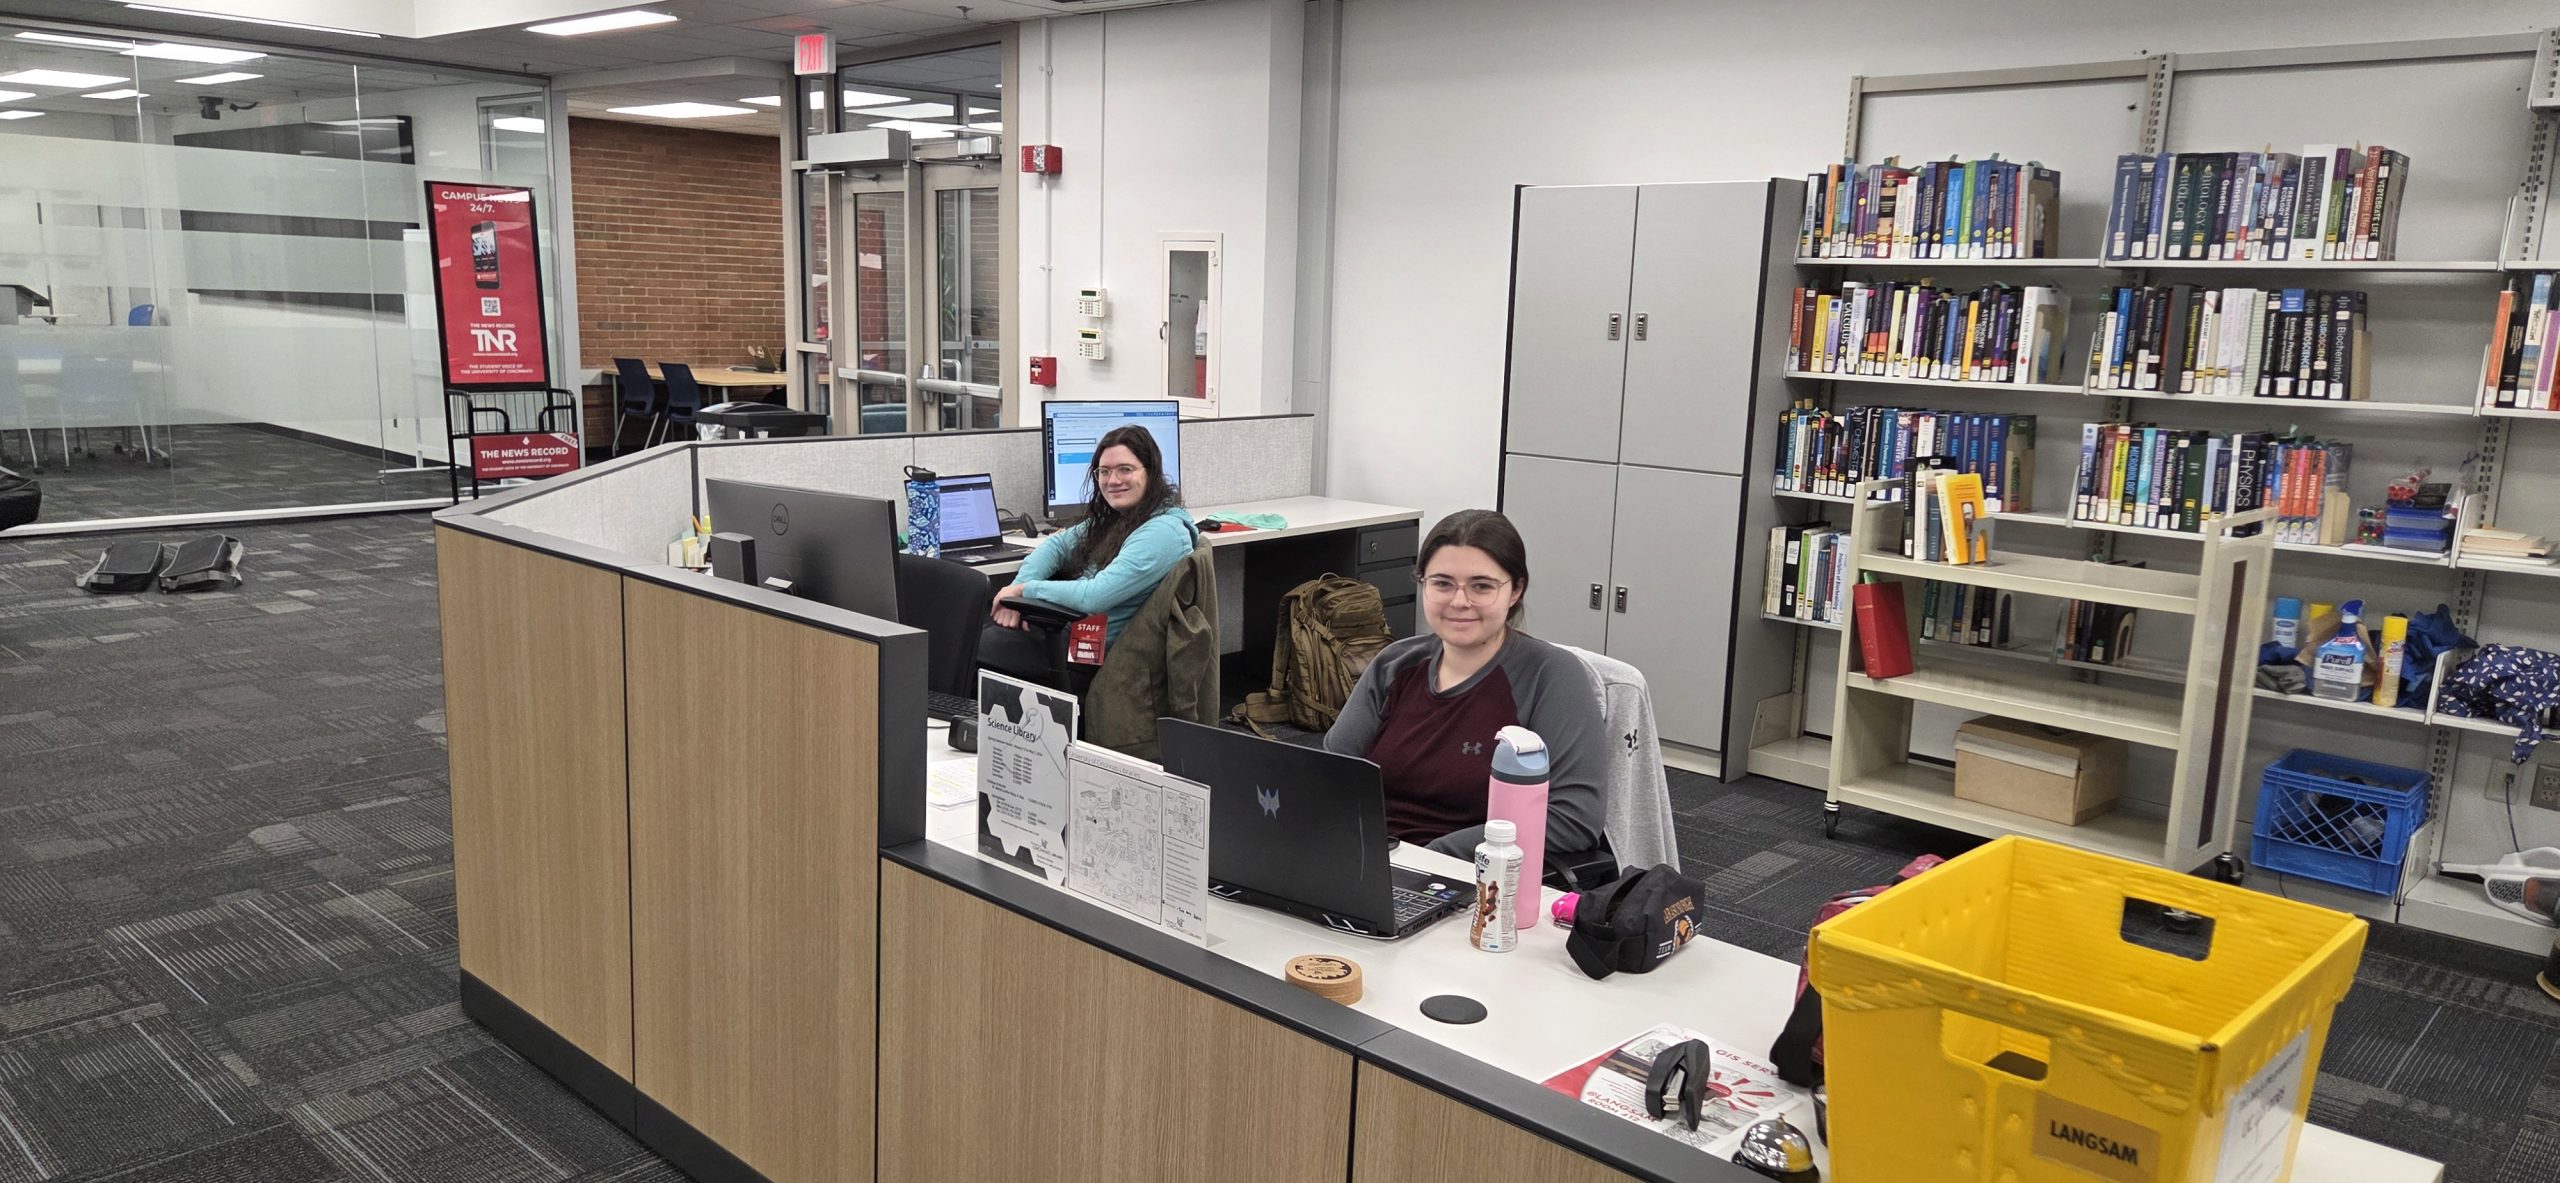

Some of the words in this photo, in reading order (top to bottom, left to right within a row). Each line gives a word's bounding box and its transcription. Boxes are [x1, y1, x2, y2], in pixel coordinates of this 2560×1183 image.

[799, 34, 824, 71] EXIT
[2231, 177, 2245, 213] Genetics
[2305, 160, 2317, 202] MOLECULAR
[2363, 165, 2376, 211] Vertebrate
[470, 203, 495, 213] 24/7.
[2195, 173, 2214, 226] BIOLOGY
[2218, 179, 2230, 215] Genetics
[2258, 186, 2269, 219] ECOLOGY
[2278, 187, 2288, 215] ECOLOGY
[2283, 187, 2293, 227] FRESHWATER
[2372, 179, 2385, 221] VERTEBRATE
[2301, 204, 2311, 235] BIOLOGY
[2360, 214, 2370, 228] Life
[2370, 223, 2379, 237] LIFE
[1841, 302, 1852, 344] CALCULUS
[1978, 309, 1988, 348] ASTRONOMY
[2024, 306, 2032, 332] COLLEGE
[2094, 313, 2106, 351] Ornithology
[2189, 305, 2200, 346] Developmental
[2289, 317, 2297, 340] Exercise
[470, 329, 518, 352] TNR
[2300, 317, 2314, 368] NEUROSCIENCE
[2317, 314, 2328, 361] NEUROSCIEN
[2185, 348, 2194, 368] Biology
[2285, 342, 2294, 372] Physiology
[2332, 327, 2346, 383] Biochemistry
[1884, 419, 1892, 443] Quantitative
[480, 450, 499, 459] THE
[501, 448, 529, 458] NEWS
[531, 447, 569, 456] RECORD
[1851, 429, 1862, 470] CHEMISTR
[1990, 441, 1998, 461] ORGANIC
[2117, 441, 2126, 472] Microbiology
[2126, 446, 2139, 495] MICROBIOLOGY
[2163, 464, 2173, 498] IMMUNOLO
[2237, 449, 2256, 507] PHYSICS
[2280, 473, 2288, 498] ATISTICS
[2294, 475, 2302, 498] ATISTICS
[2308, 475, 2317, 499] ATISTICS
[773, 515, 787, 524] DELL
[1836, 553, 1844, 574] Principles
[1833, 582, 1841, 610] Biochemistry
[1077, 623, 1100, 632] STAFF
[987, 717, 1012, 734] Science
[1013, 725, 1037, 743] Library
[1715, 1049, 1740, 1062] GIS
[1742, 1061, 1779, 1076] SERV
[1586, 1090, 1663, 1123] @LANGSAM
[1587, 1098, 1621, 1114] ROOM
[2050, 1119, 2140, 1166] LANGSAM
